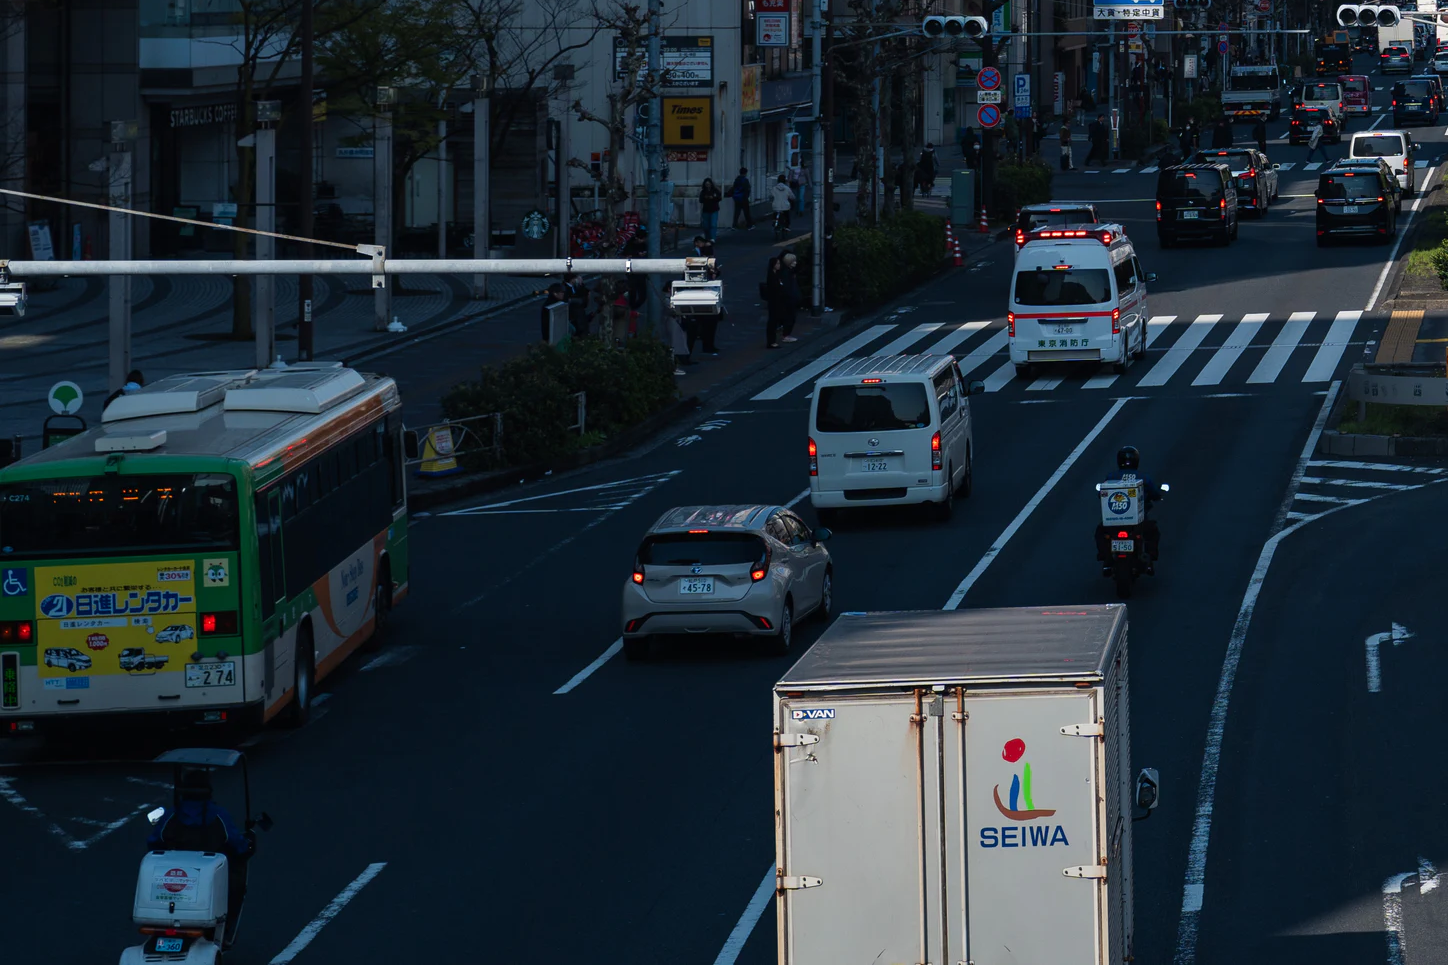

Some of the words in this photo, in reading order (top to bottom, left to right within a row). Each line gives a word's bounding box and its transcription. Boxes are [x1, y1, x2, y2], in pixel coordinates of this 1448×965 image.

[1017, 77, 1026, 89] P
[671, 105, 704, 114] Times
[170, 106, 213, 128] STARBUCKS
[1038, 338, 1090, 347] 東京消防庁
[867, 462, 888, 471] 12-22
[687, 583, 712, 593] 45-78
[75, 590, 193, 616] 日進レンタカー
[63, 620, 110, 628] 日進レンタカー
[980, 825, 1070, 848] SEIWA
